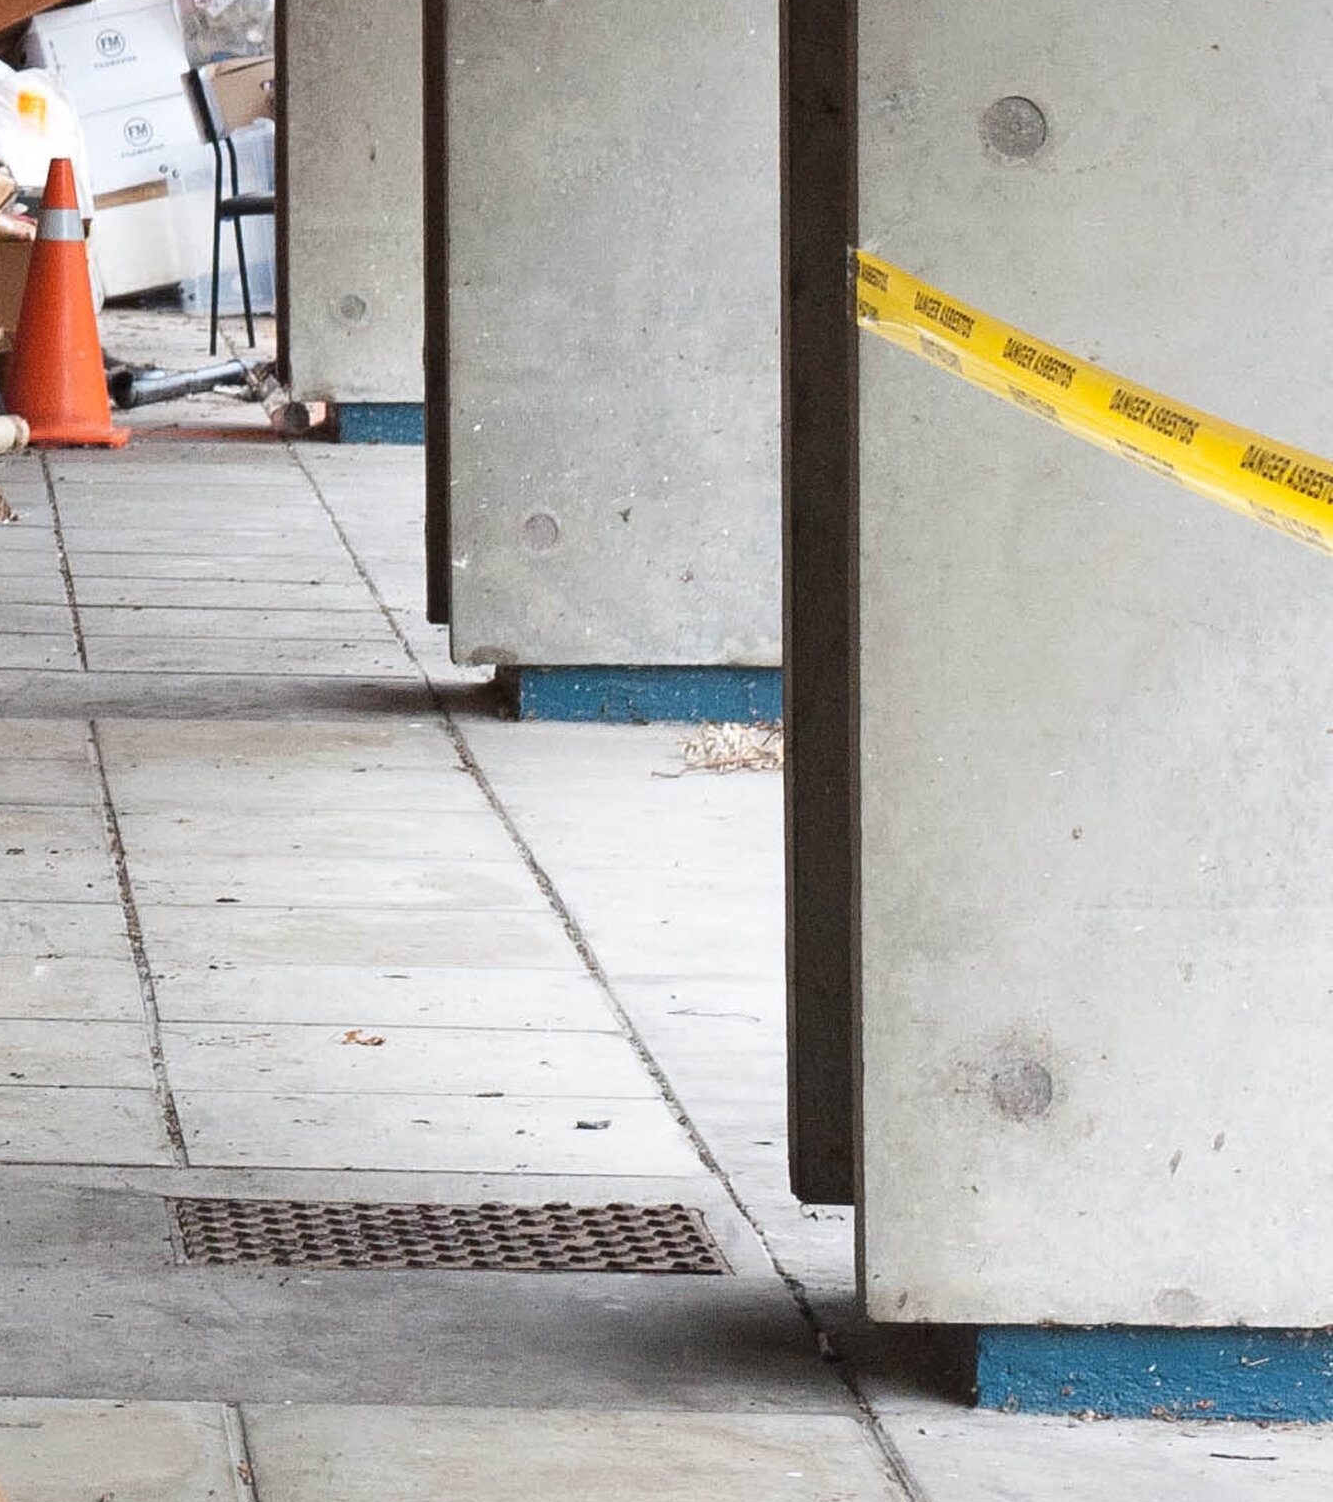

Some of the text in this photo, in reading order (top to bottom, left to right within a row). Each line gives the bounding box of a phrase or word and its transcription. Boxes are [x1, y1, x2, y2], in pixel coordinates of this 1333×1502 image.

[1002, 337, 1037, 370] DANGER
[1032, 352, 1077, 390] ASBESTOS
[1109, 388, 1151, 426] DANGER
[1145, 405, 1201, 446] ASBESTOS
[1239, 444, 1291, 485] DANGER
